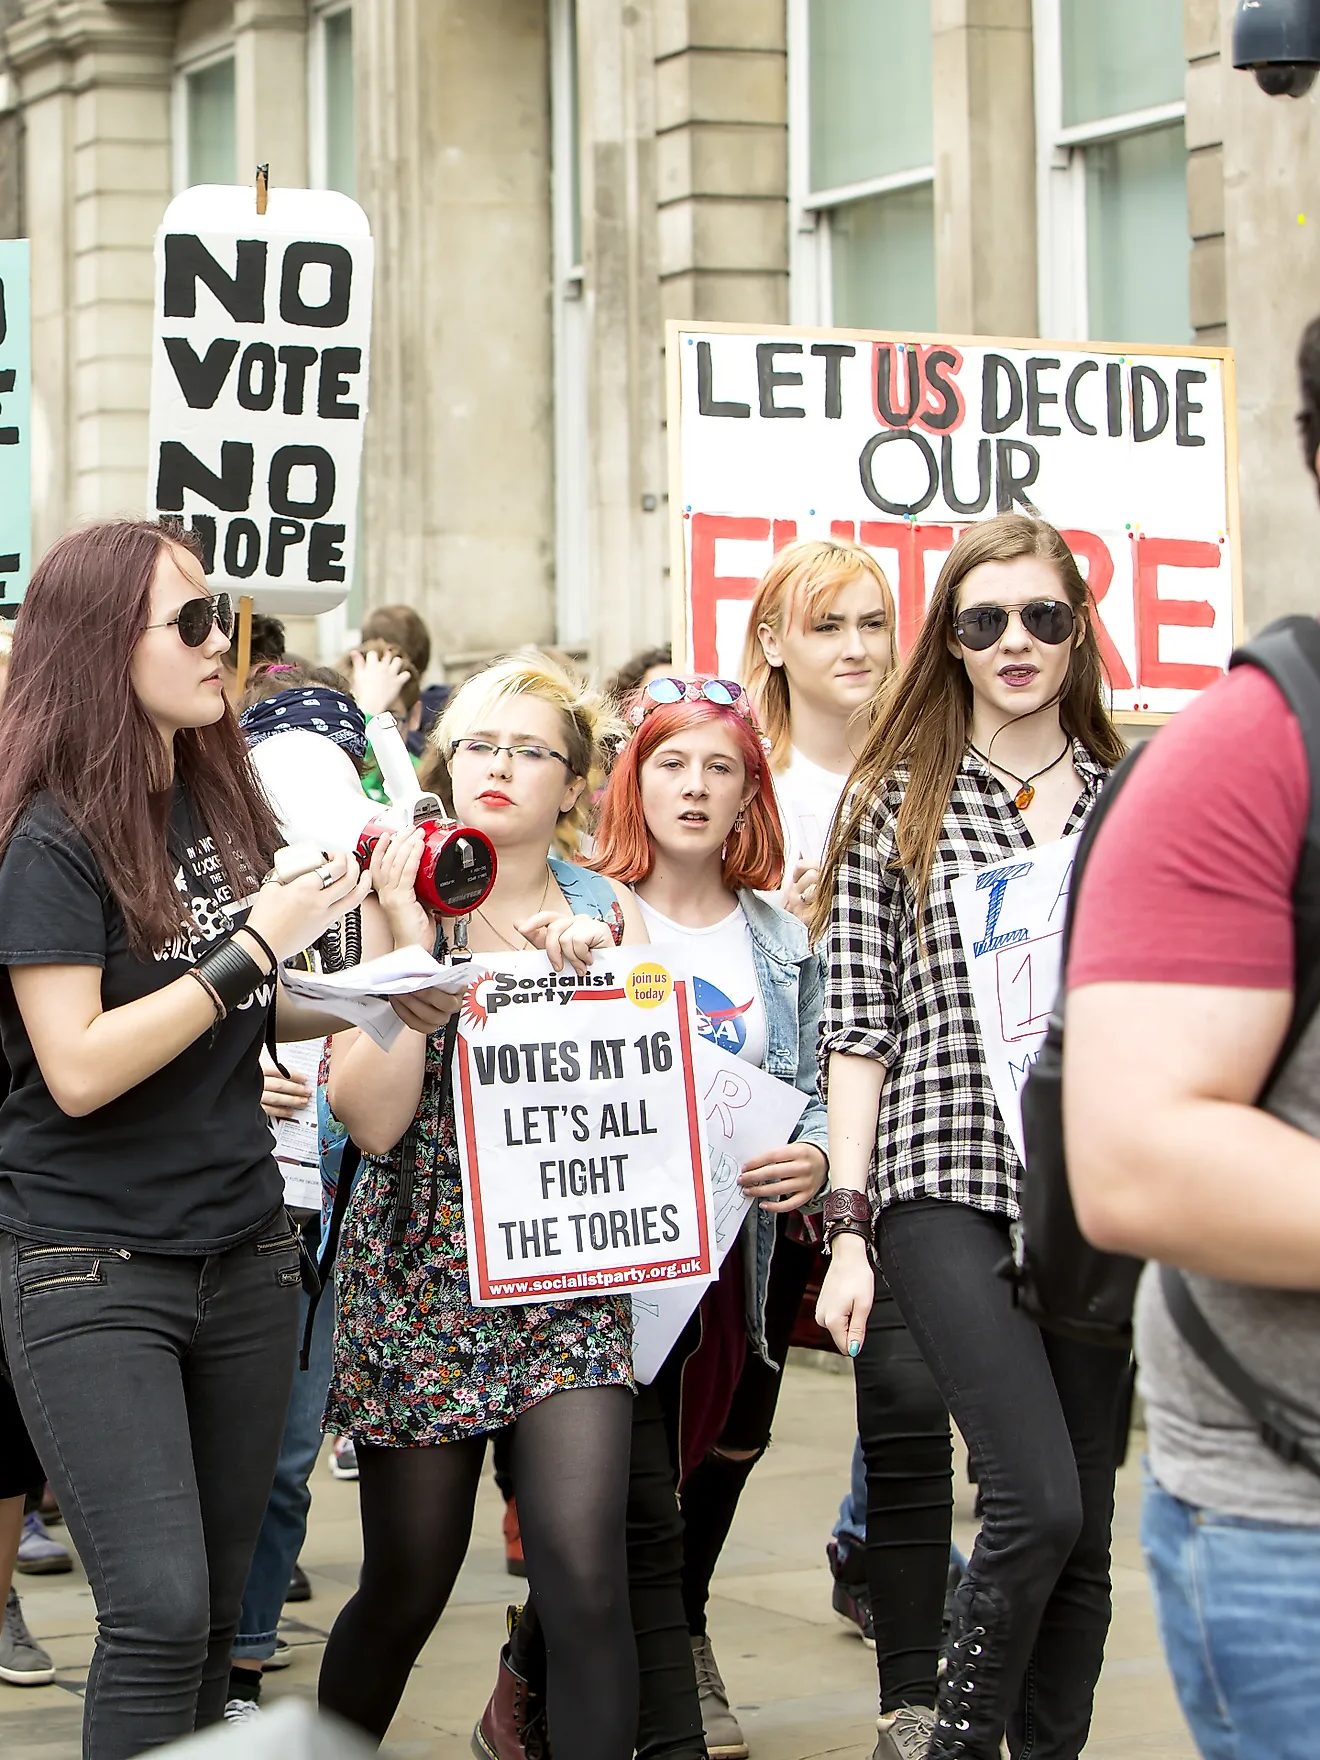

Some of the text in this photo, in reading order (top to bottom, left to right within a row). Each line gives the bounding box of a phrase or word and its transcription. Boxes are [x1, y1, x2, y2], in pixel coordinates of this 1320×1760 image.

[162, 233, 353, 328] NO
[161, 336, 362, 419] VOTE
[696, 340, 1207, 447] LET US DECIDE
[157, 440, 336, 520] NO
[859, 429, 1041, 518] OUR
[691, 512, 1226, 690] FTRE
[494, 971, 615, 991] Socialist
[632, 972, 667, 987] join us
[635, 987, 665, 1002] today
[473, 1031, 673, 1085] VOTES AT 16
[504, 1099, 657, 1146] LET'S ALL
[539, 1154, 629, 1200] FIGHT
[499, 1216, 561, 1260] THE
[568, 1204, 680, 1253] TORIES
[489, 1258, 702, 1296] www.socialistparty.org.uk
